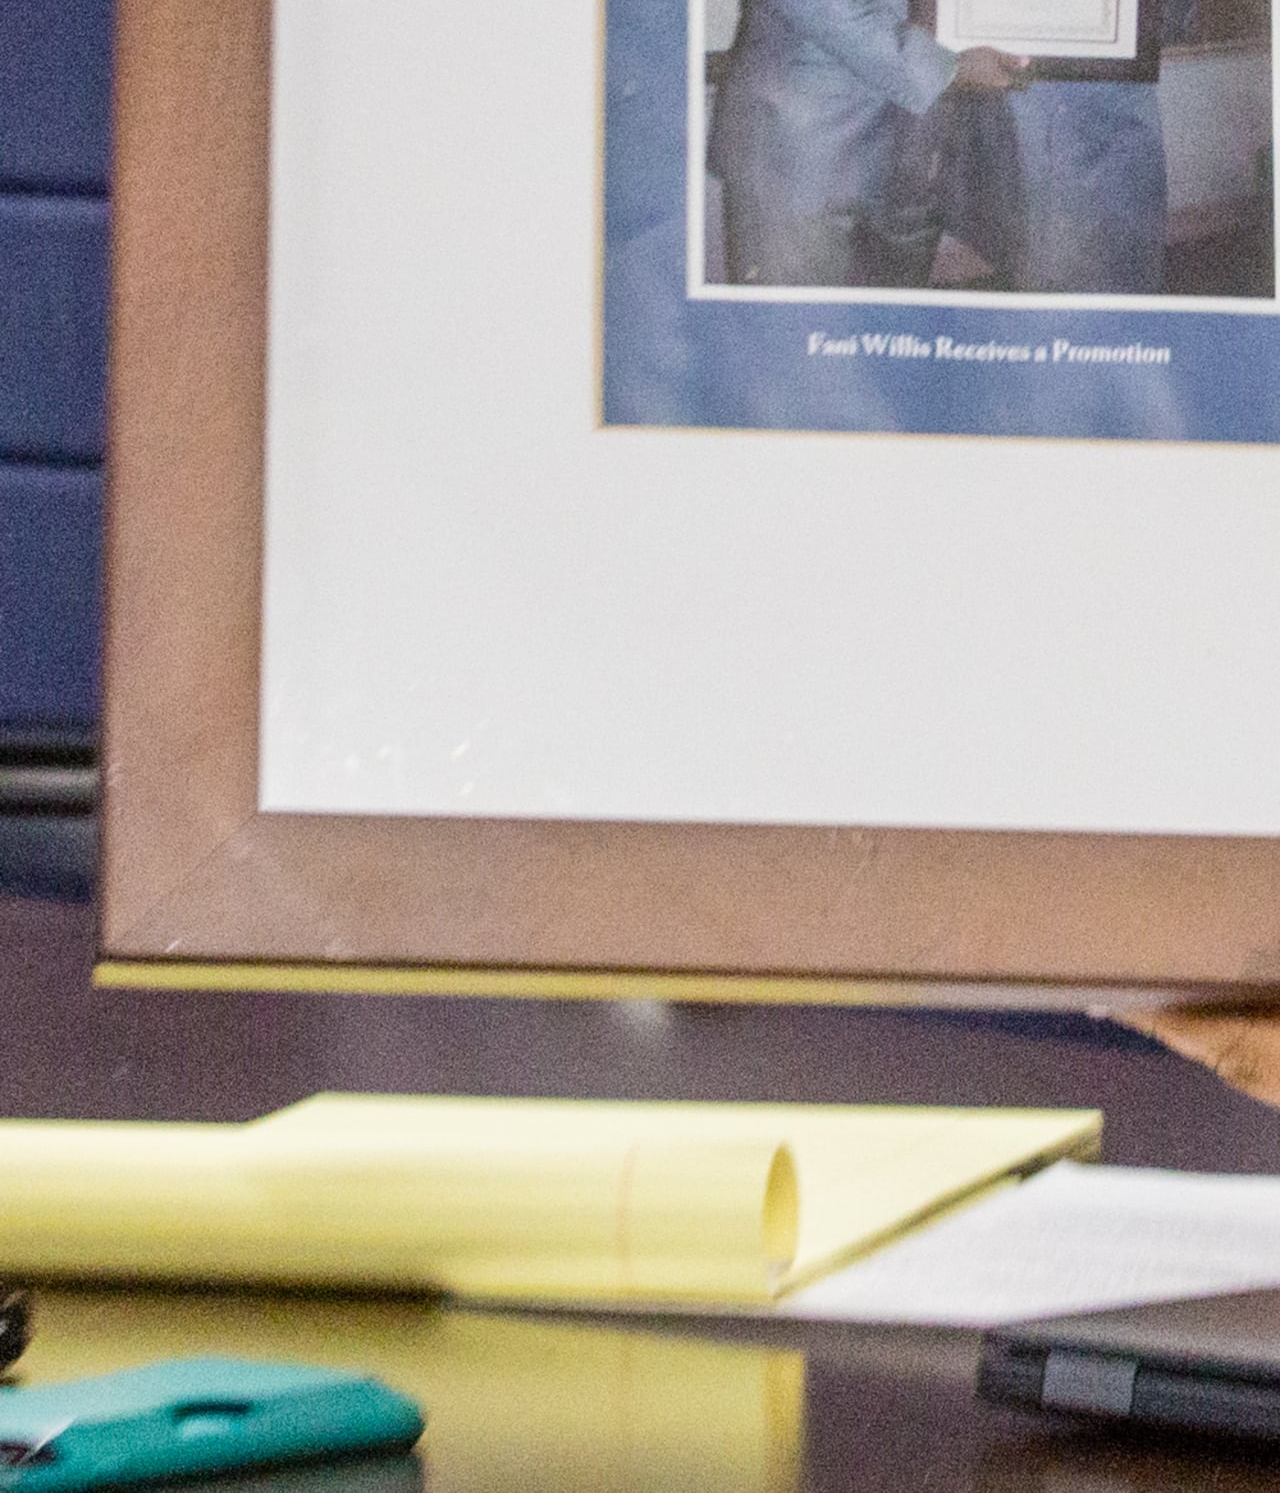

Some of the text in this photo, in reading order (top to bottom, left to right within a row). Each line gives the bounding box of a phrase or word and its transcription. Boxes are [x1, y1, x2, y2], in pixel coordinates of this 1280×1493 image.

[861, 333, 932, 357] Willis
[935, 336, 1031, 362] Receives
[1034, 345, 1047, 363] a
[1052, 338, 1171, 364] Promotion
